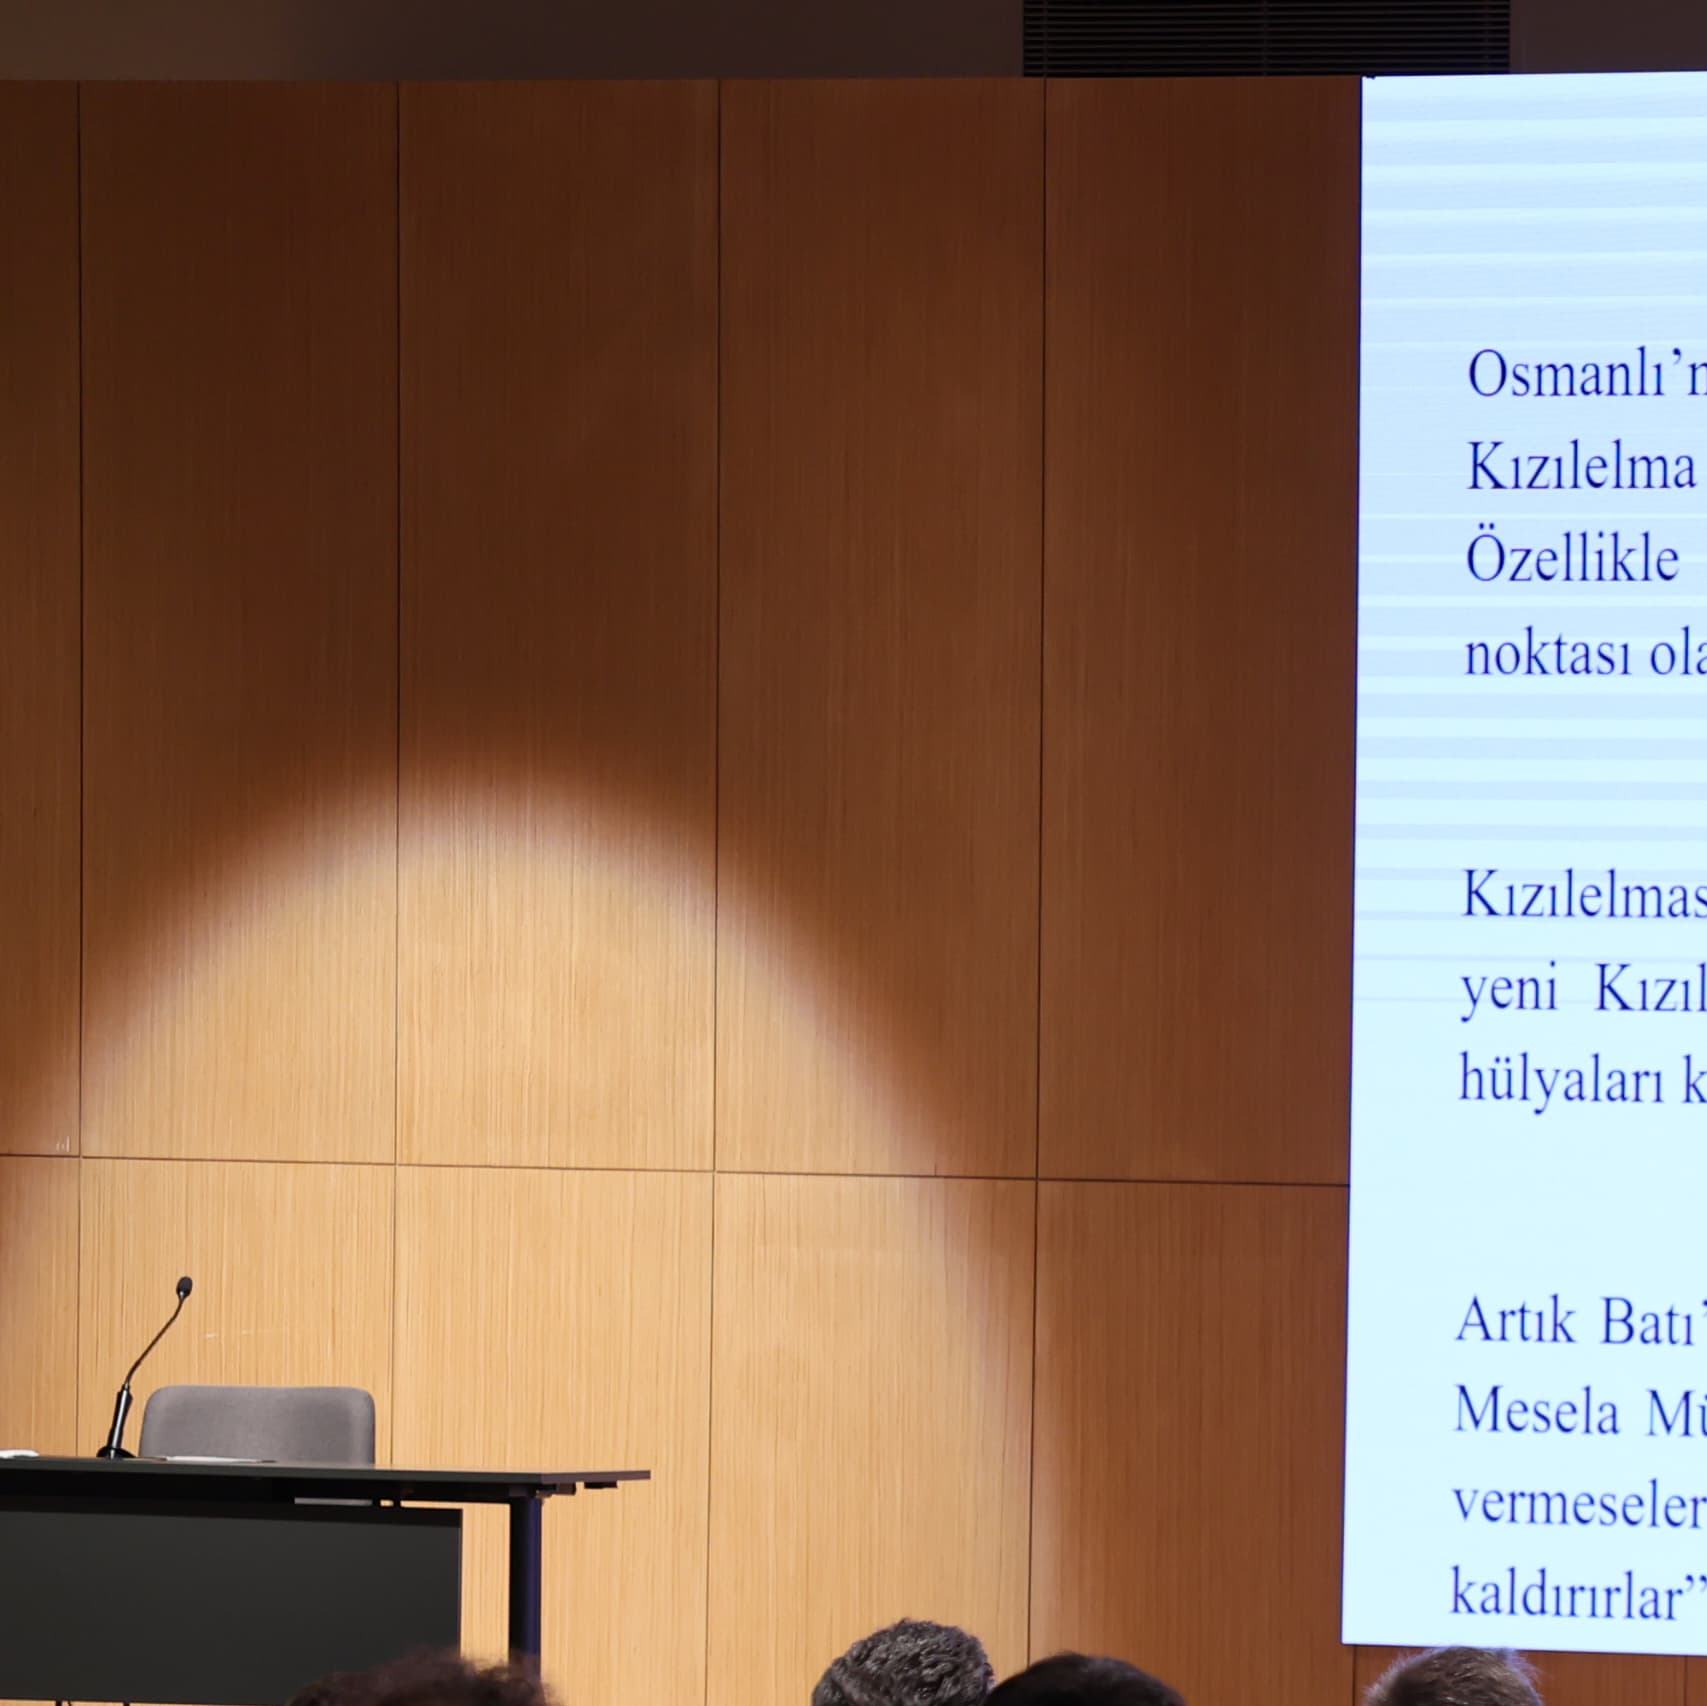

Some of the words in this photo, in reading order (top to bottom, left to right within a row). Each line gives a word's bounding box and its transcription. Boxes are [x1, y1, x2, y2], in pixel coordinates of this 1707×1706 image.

[1466, 437, 1698, 491] Kızılelma
[1465, 521, 1680, 583] Özellikle
[1465, 623, 1633, 677] noktası
[1459, 958, 1559, 1024] yeni
[1459, 1049, 1664, 1117] hülyaları
[1454, 1292, 1577, 1344] Artık
[1456, 1383, 1621, 1436] Mesela
